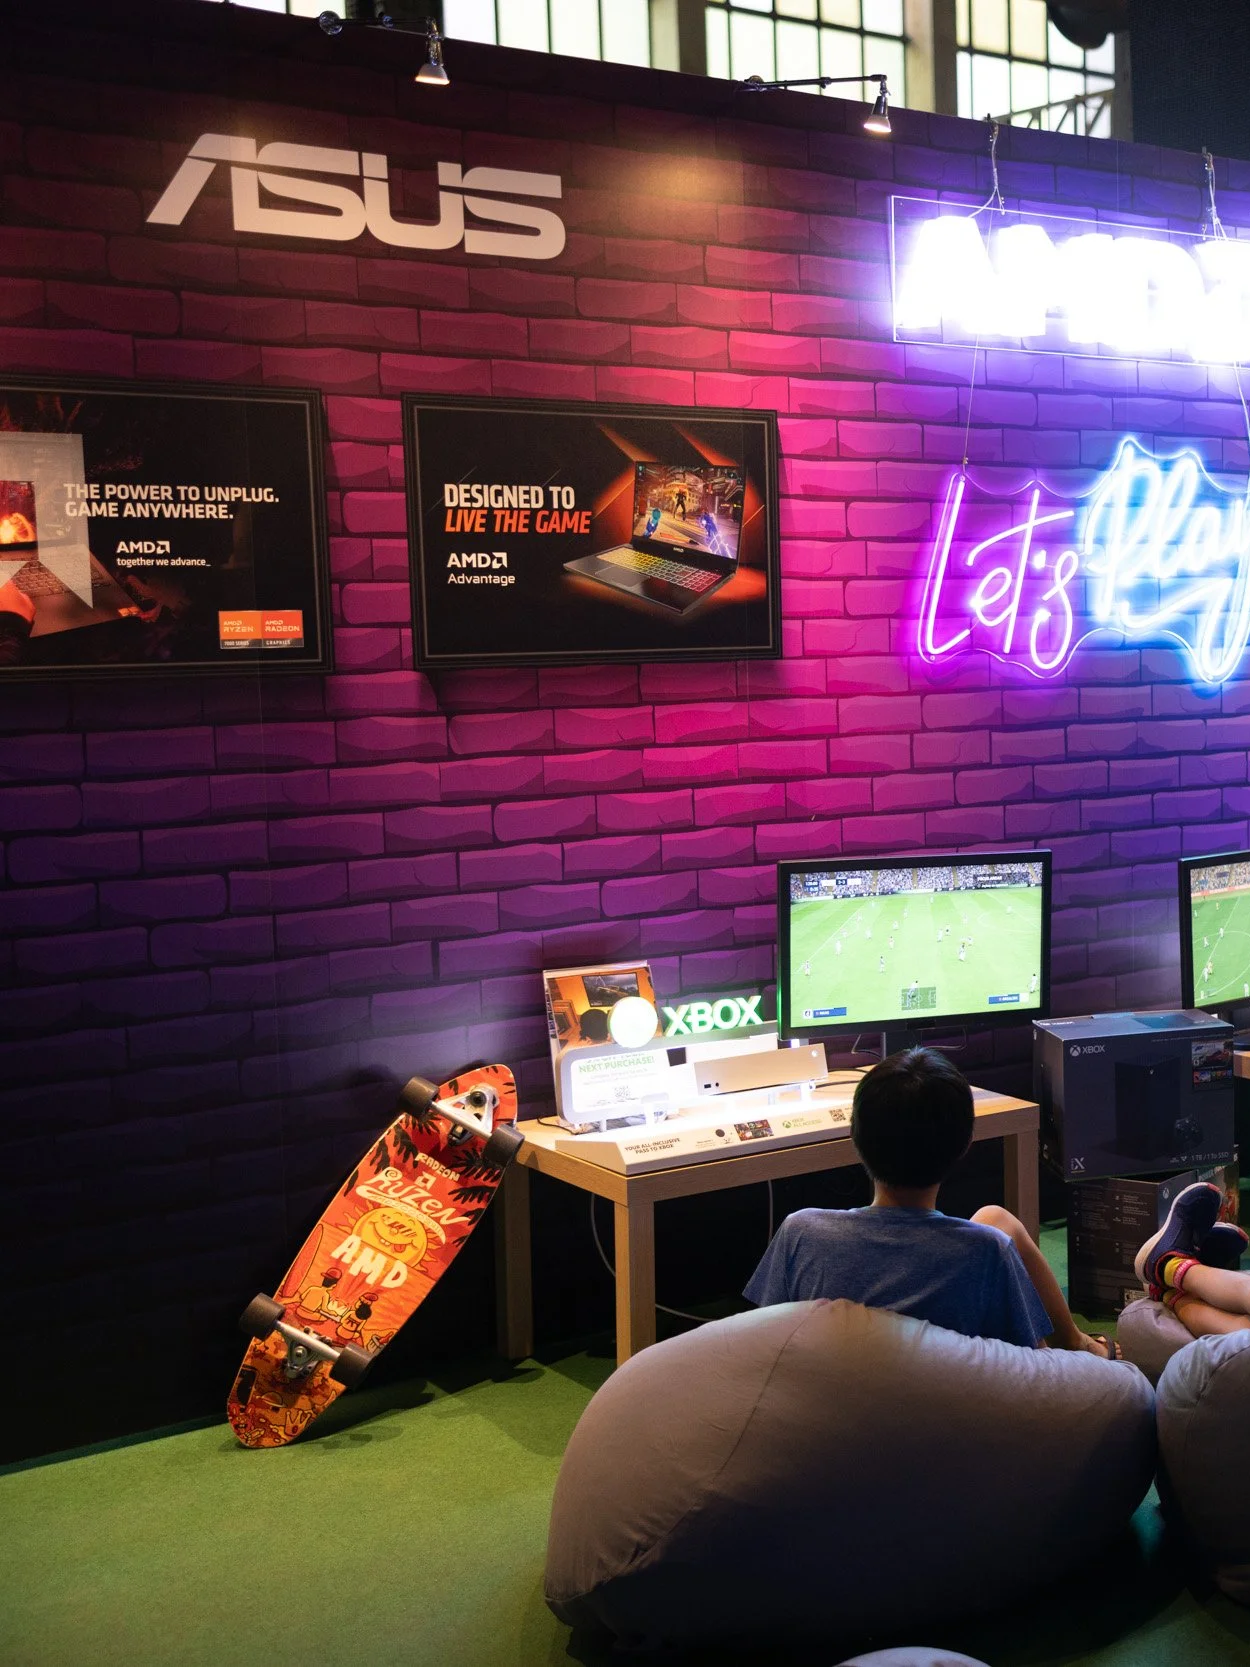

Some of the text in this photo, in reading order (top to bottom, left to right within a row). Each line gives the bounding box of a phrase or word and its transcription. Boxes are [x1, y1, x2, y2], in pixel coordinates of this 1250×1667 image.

[146, 133, 566, 260] ASUS
[64, 484, 280, 503] THE POWER TO UNPLUG.
[444, 484, 576, 510] DESIGNED TO
[65, 502, 234, 520] GAME ANYWHERE.
[445, 509, 592, 534] LIVE THE GAME
[116, 541, 156, 554] AMD
[117, 557, 154, 567] together
[156, 558, 169, 566] we
[446, 552, 492, 568] AMD
[447, 573, 516, 587] Advantage
[926, 478, 1079, 670] Let's
[661, 995, 764, 1037] XBOX
[1082, 1045, 1105, 1054] XBOX
[579, 1063, 603, 1073] NEXT
[604, 1055, 655, 1071] PURCHASE!
[415, 1152, 460, 1182] RADEON
[331, 1234, 408, 1289] AMD
